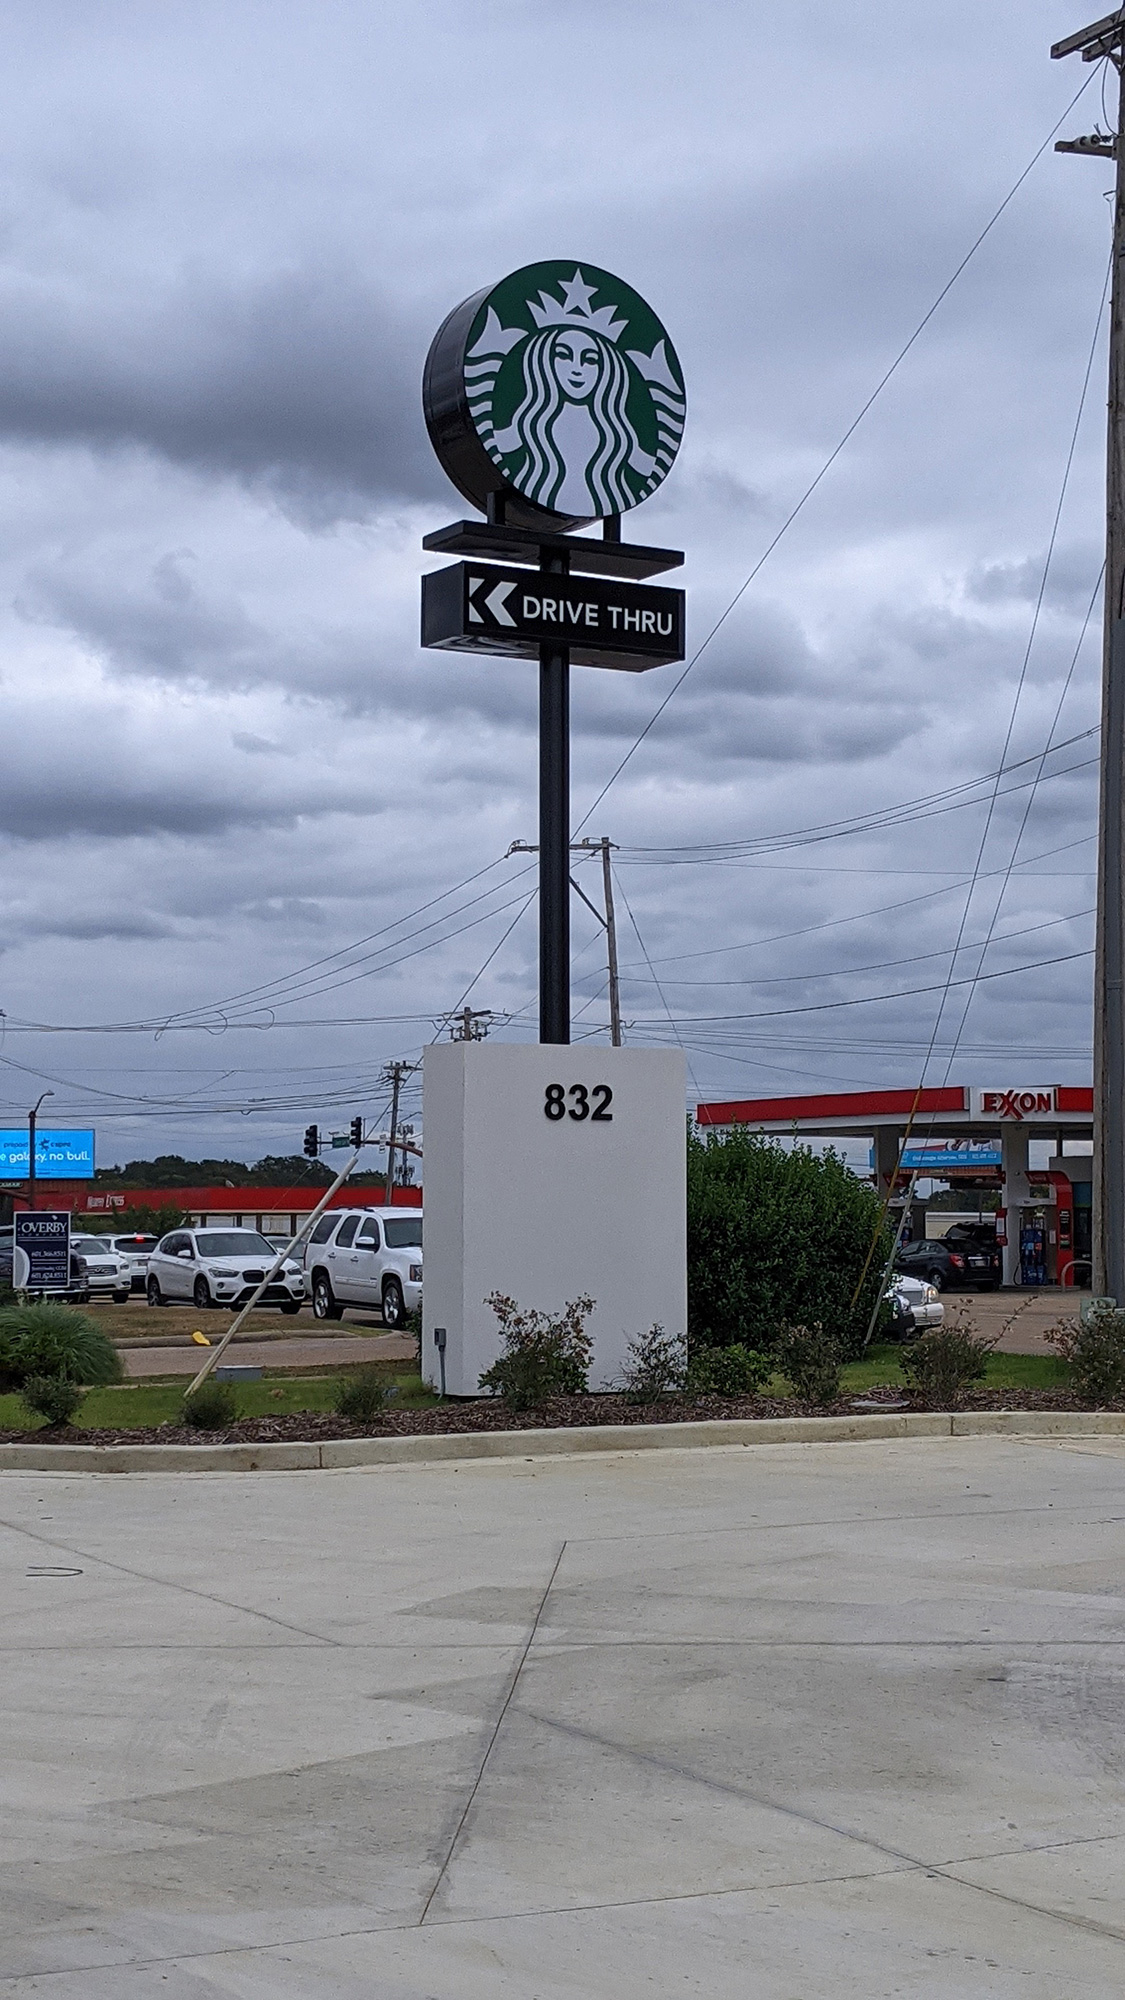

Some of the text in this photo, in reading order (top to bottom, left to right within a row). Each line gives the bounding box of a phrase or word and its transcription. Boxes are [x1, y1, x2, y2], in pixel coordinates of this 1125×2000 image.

[523, 595, 673, 636] DRIVE THRU
[544, 1083, 613, 1121] 832
[981, 1089, 1052, 1121] EXXON
[49, 1152, 64, 1161] no
[66, 1150, 90, 1161] bull.
[21, 1222, 67, 1233] OVERBY
